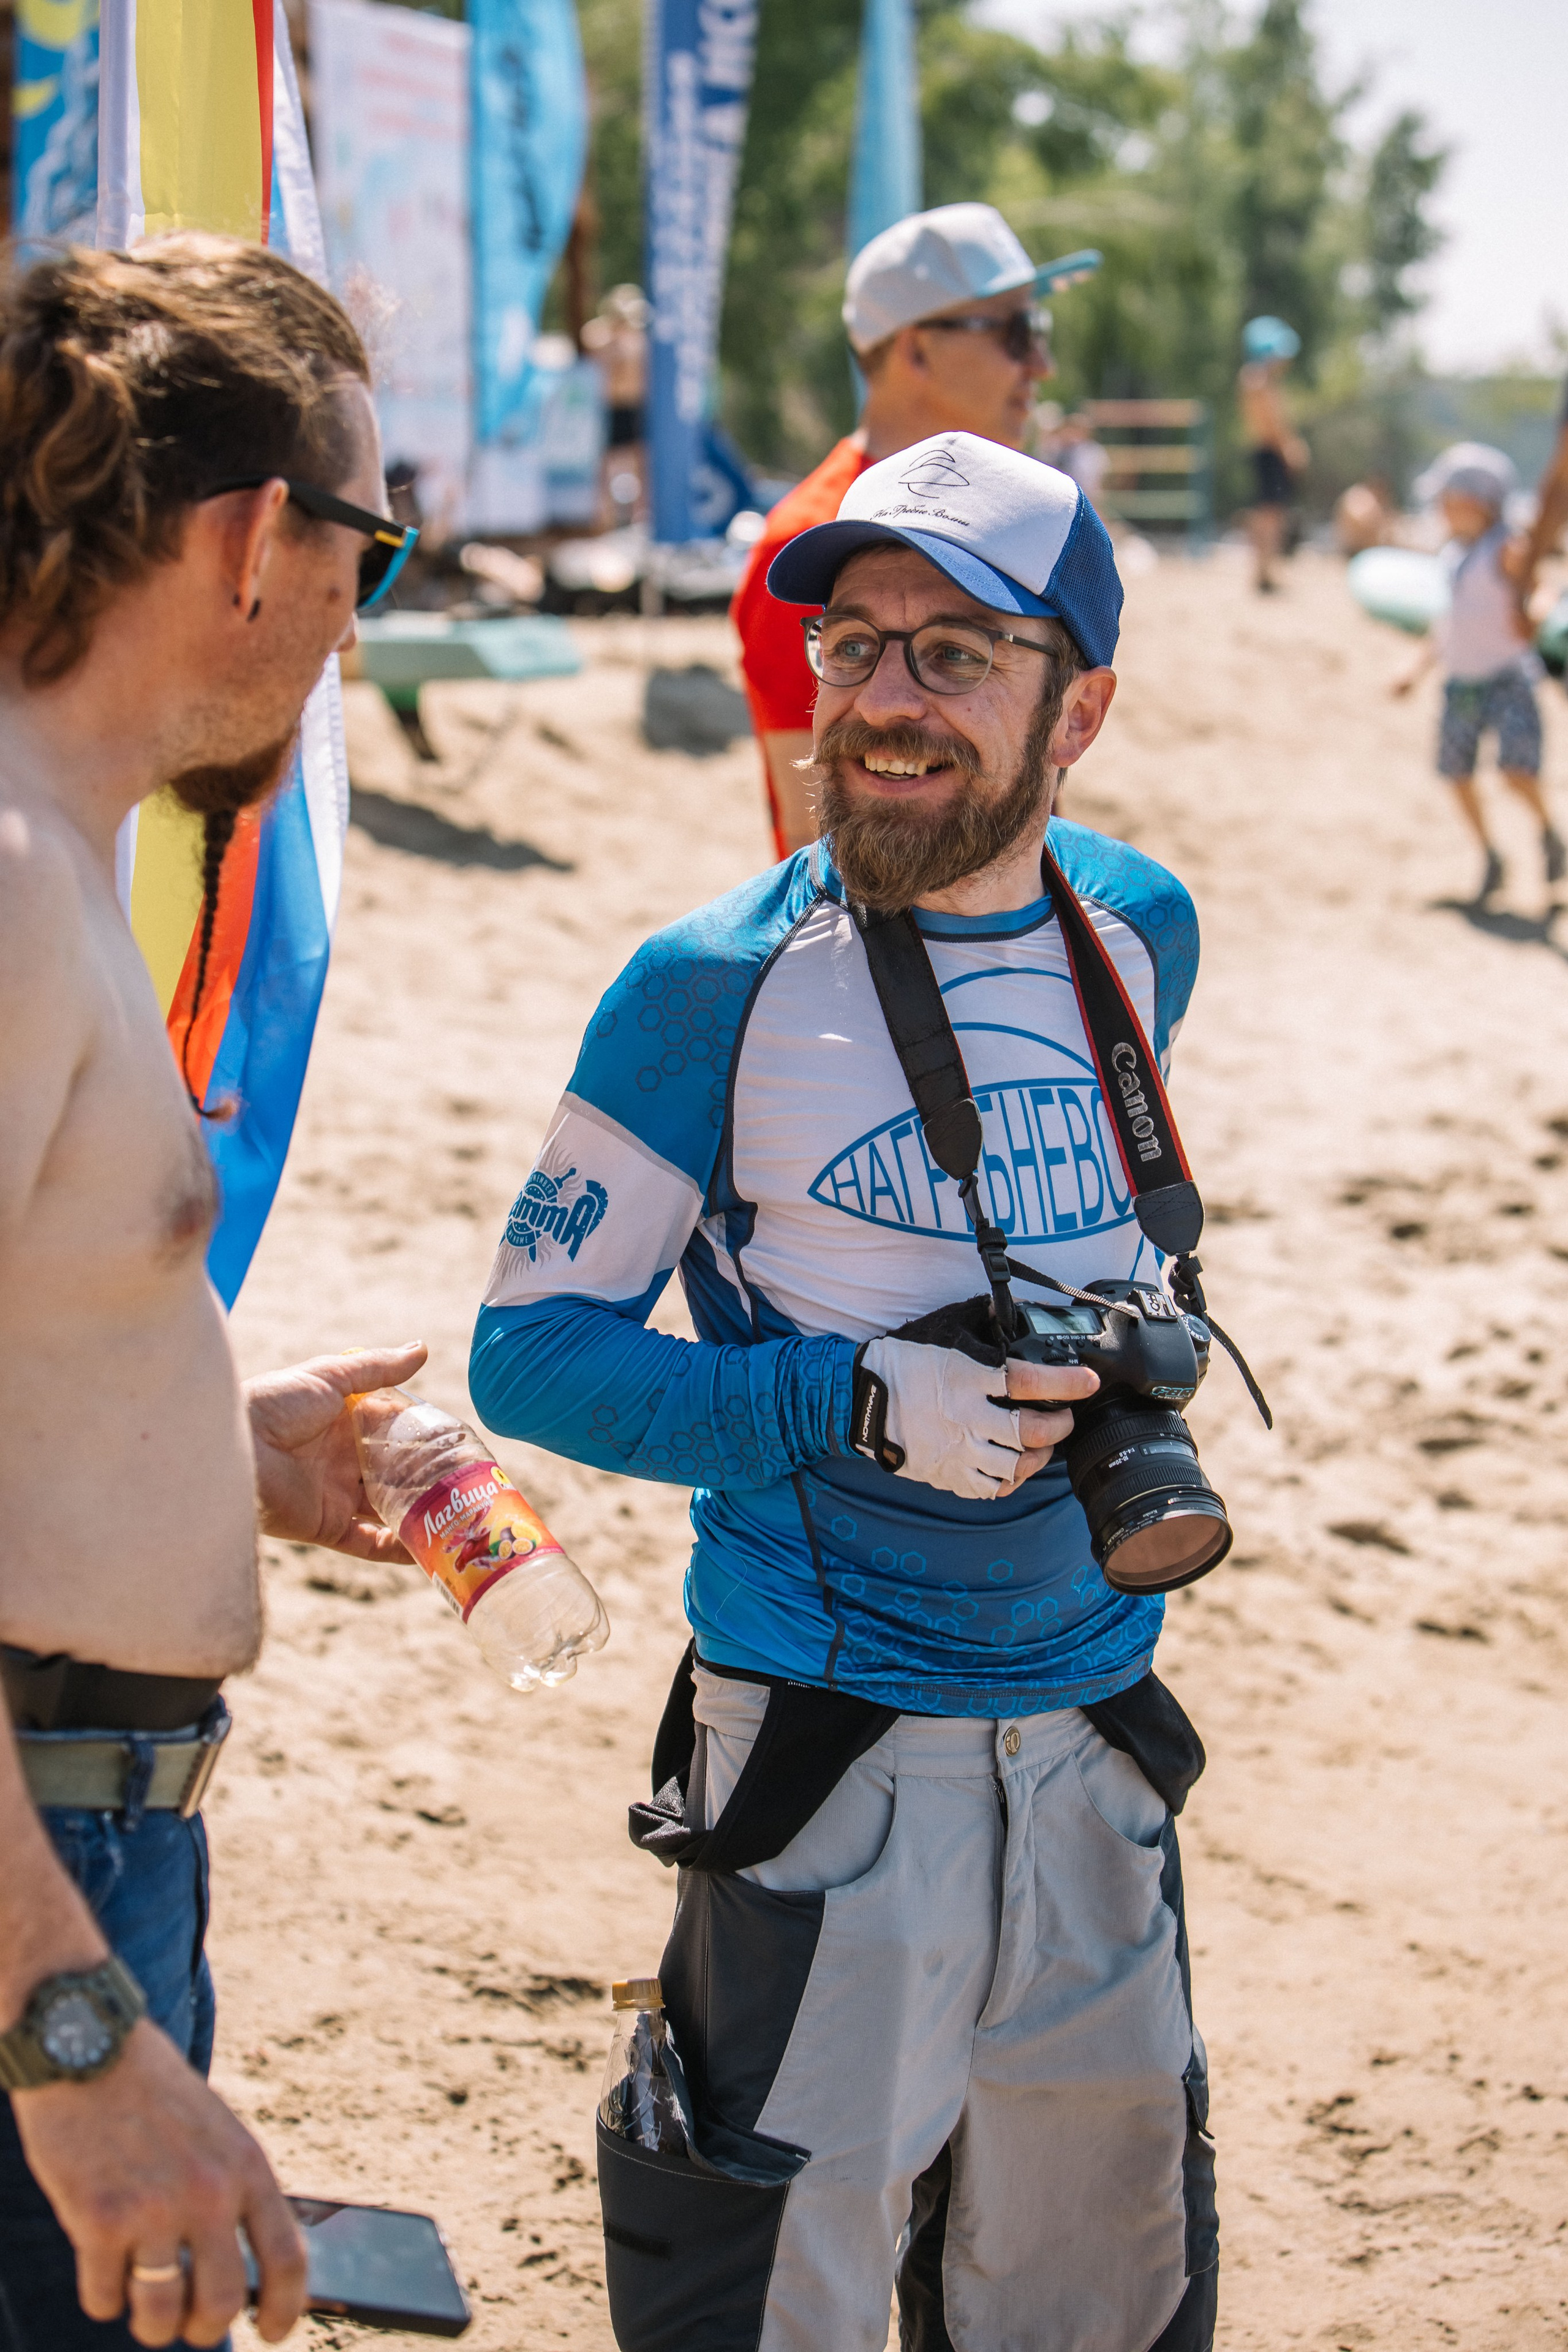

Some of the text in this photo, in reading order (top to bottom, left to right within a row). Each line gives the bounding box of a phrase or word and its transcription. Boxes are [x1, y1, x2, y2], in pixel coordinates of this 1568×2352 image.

[1112, 1042, 1161, 1162] Canon
[528, 1174, 554, 1194] EMEMBER
[862, 1384, 876, 1442] NORTHWAVE
[423, 1481, 499, 1548] Лагвица
[1142, 1509, 1158, 1518] Kenko
